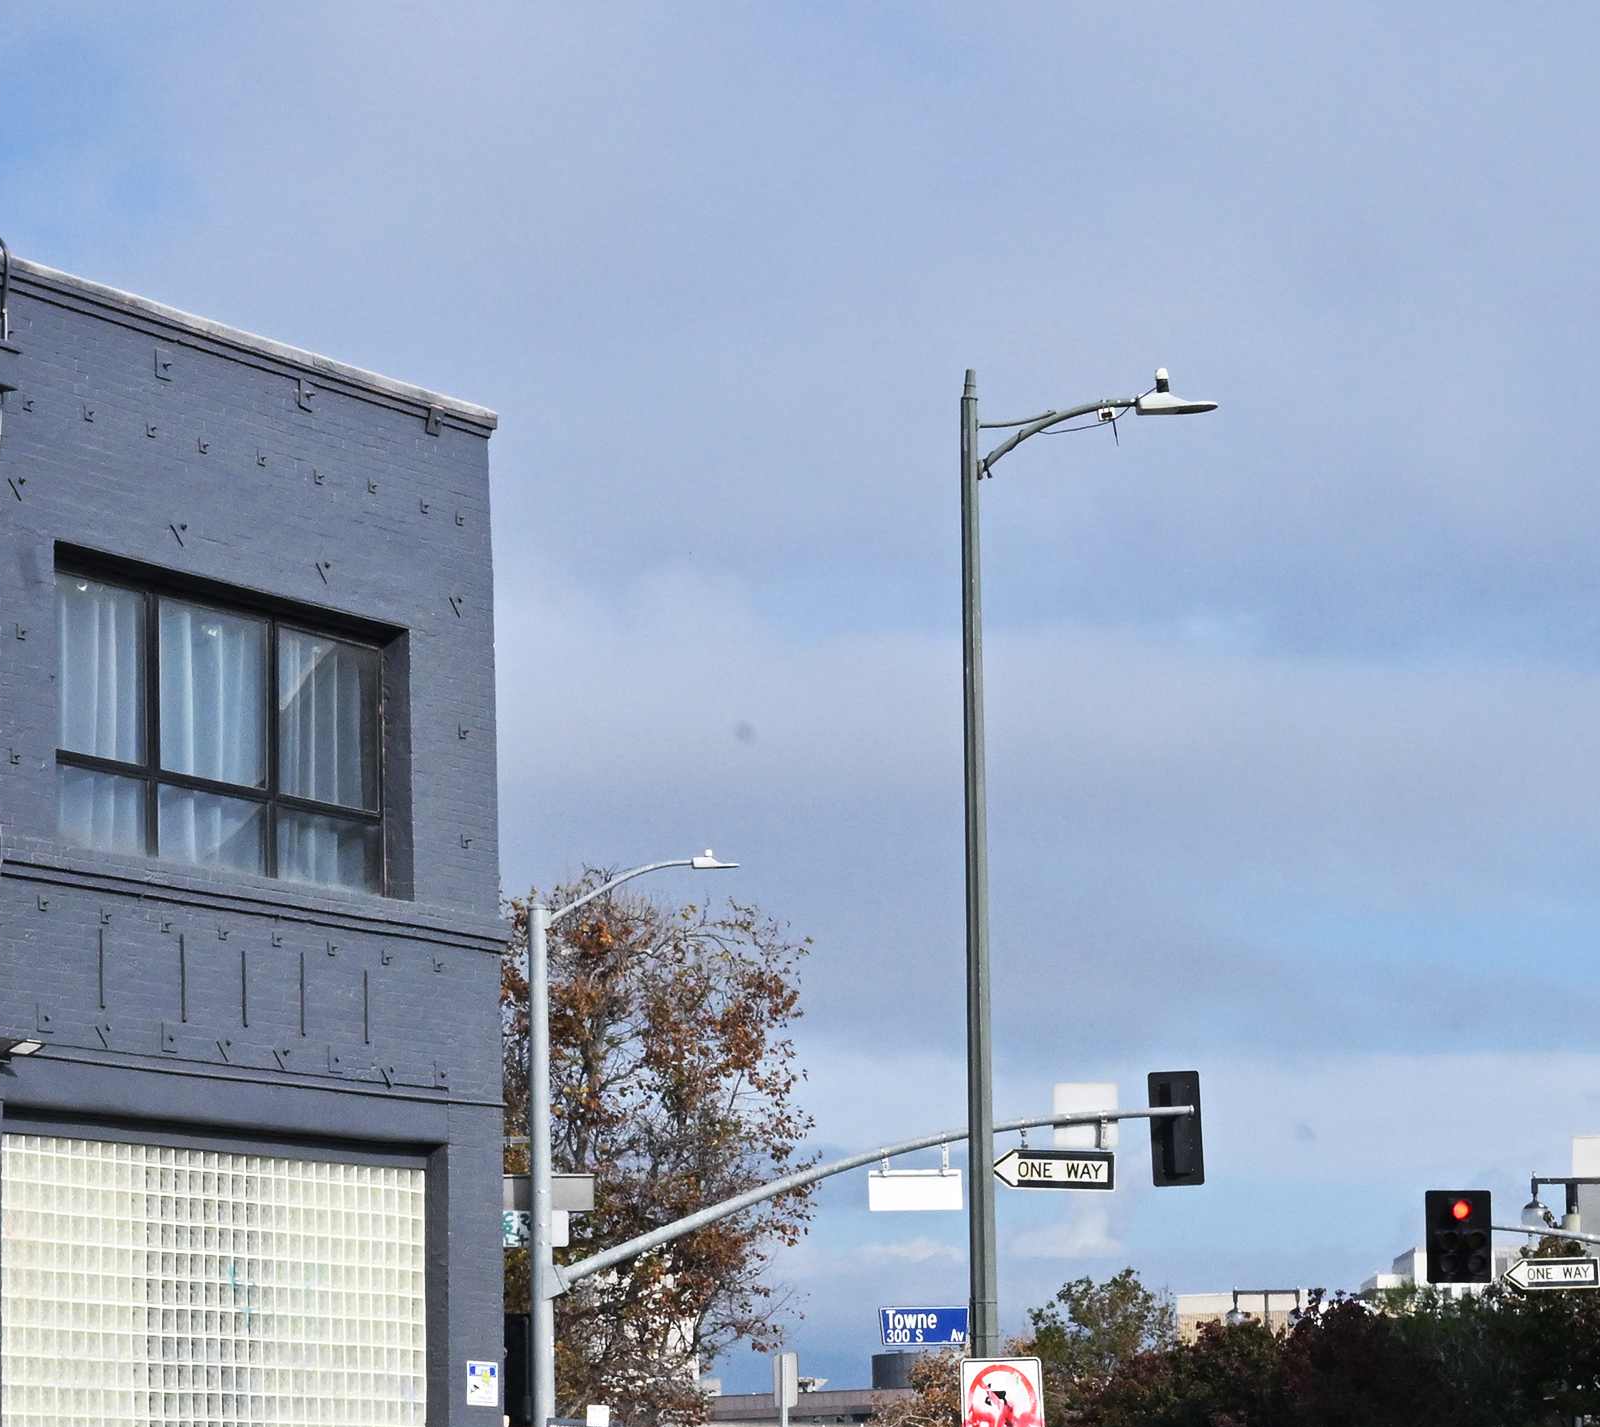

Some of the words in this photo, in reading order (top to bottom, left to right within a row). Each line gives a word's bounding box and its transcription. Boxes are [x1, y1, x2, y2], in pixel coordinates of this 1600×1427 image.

[1018, 1161, 1053, 1178] ONE
[1066, 1162, 1103, 1179] WAY
[1527, 1267, 1553, 1280] ONE
[1562, 1265, 1590, 1279] WAY
[886, 1310, 938, 1329] Towne
[886, 1329, 911, 1342] 300
[915, 1329, 924, 1342] S
[950, 1328, 965, 1342] Av
